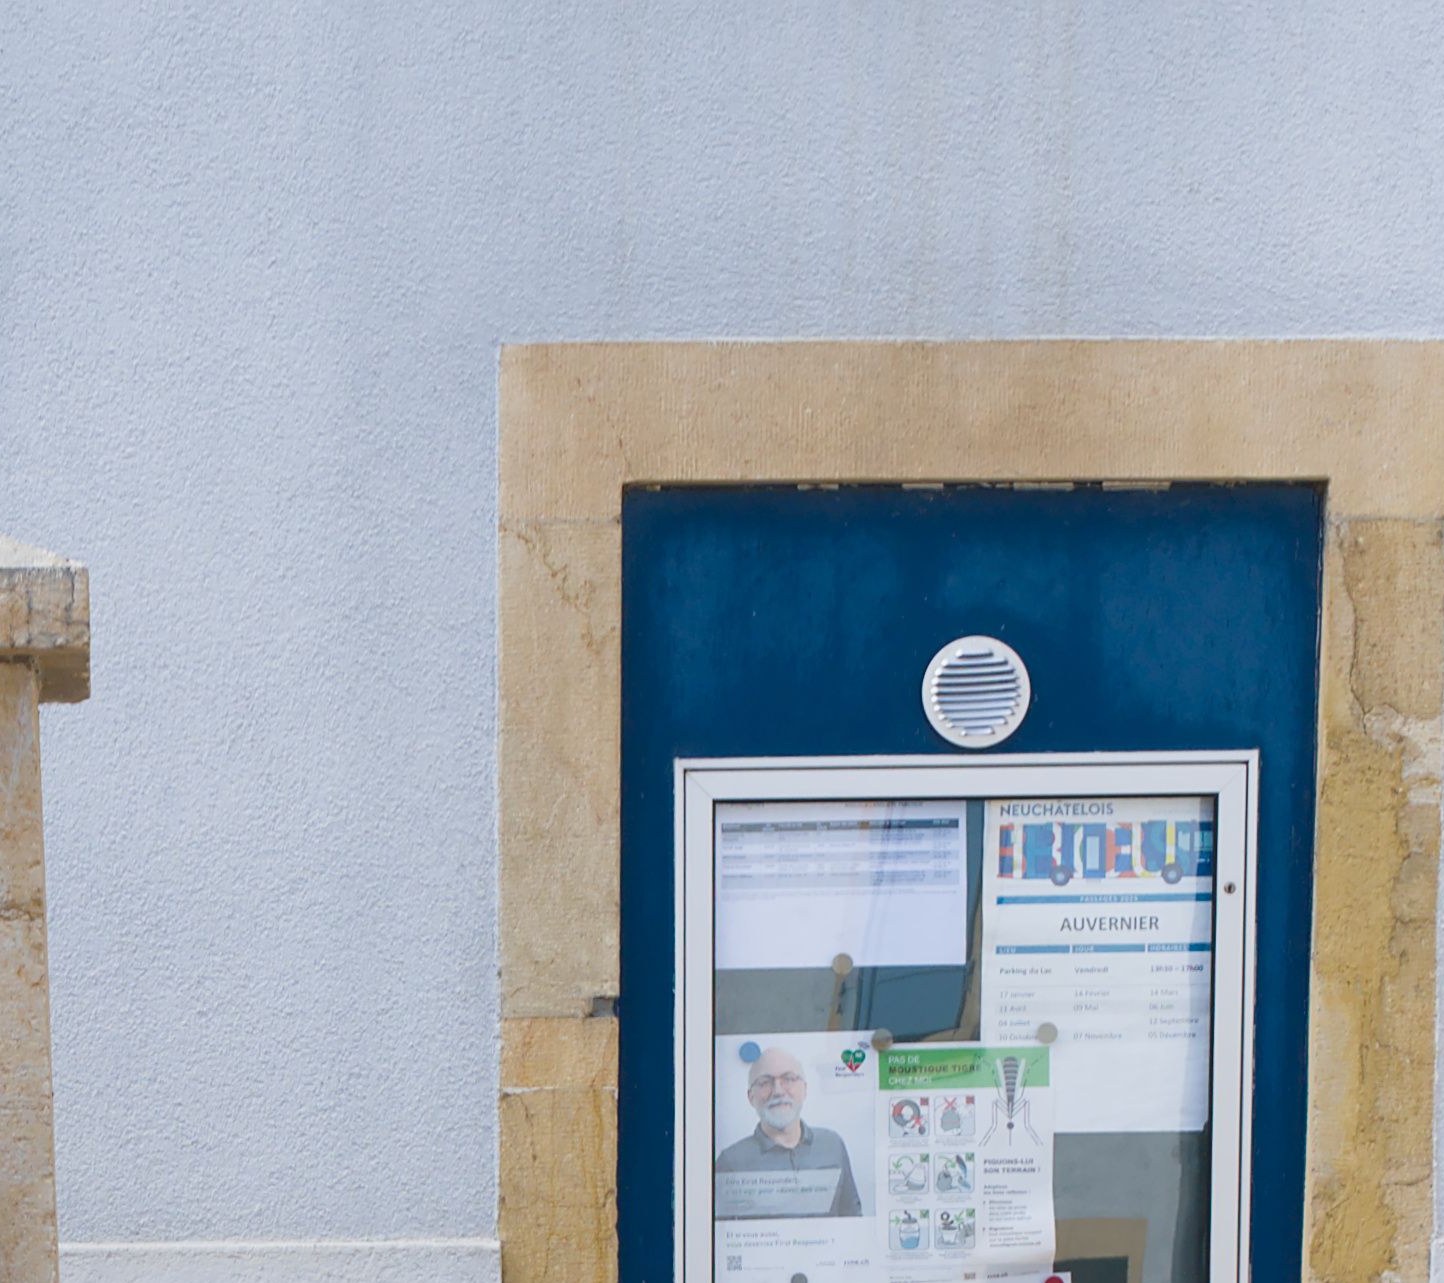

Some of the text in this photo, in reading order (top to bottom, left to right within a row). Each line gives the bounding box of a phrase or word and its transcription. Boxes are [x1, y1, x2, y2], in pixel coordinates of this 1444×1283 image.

[1059, 915, 1160, 932] AUVERNIER
[999, 967, 1027, 976] Parking
[1074, 966, 1109, 974] Vendredi
[888, 1055, 920, 1064] PAS DE
[888, 1062, 981, 1073] MOUSTIQUE TIGRE
